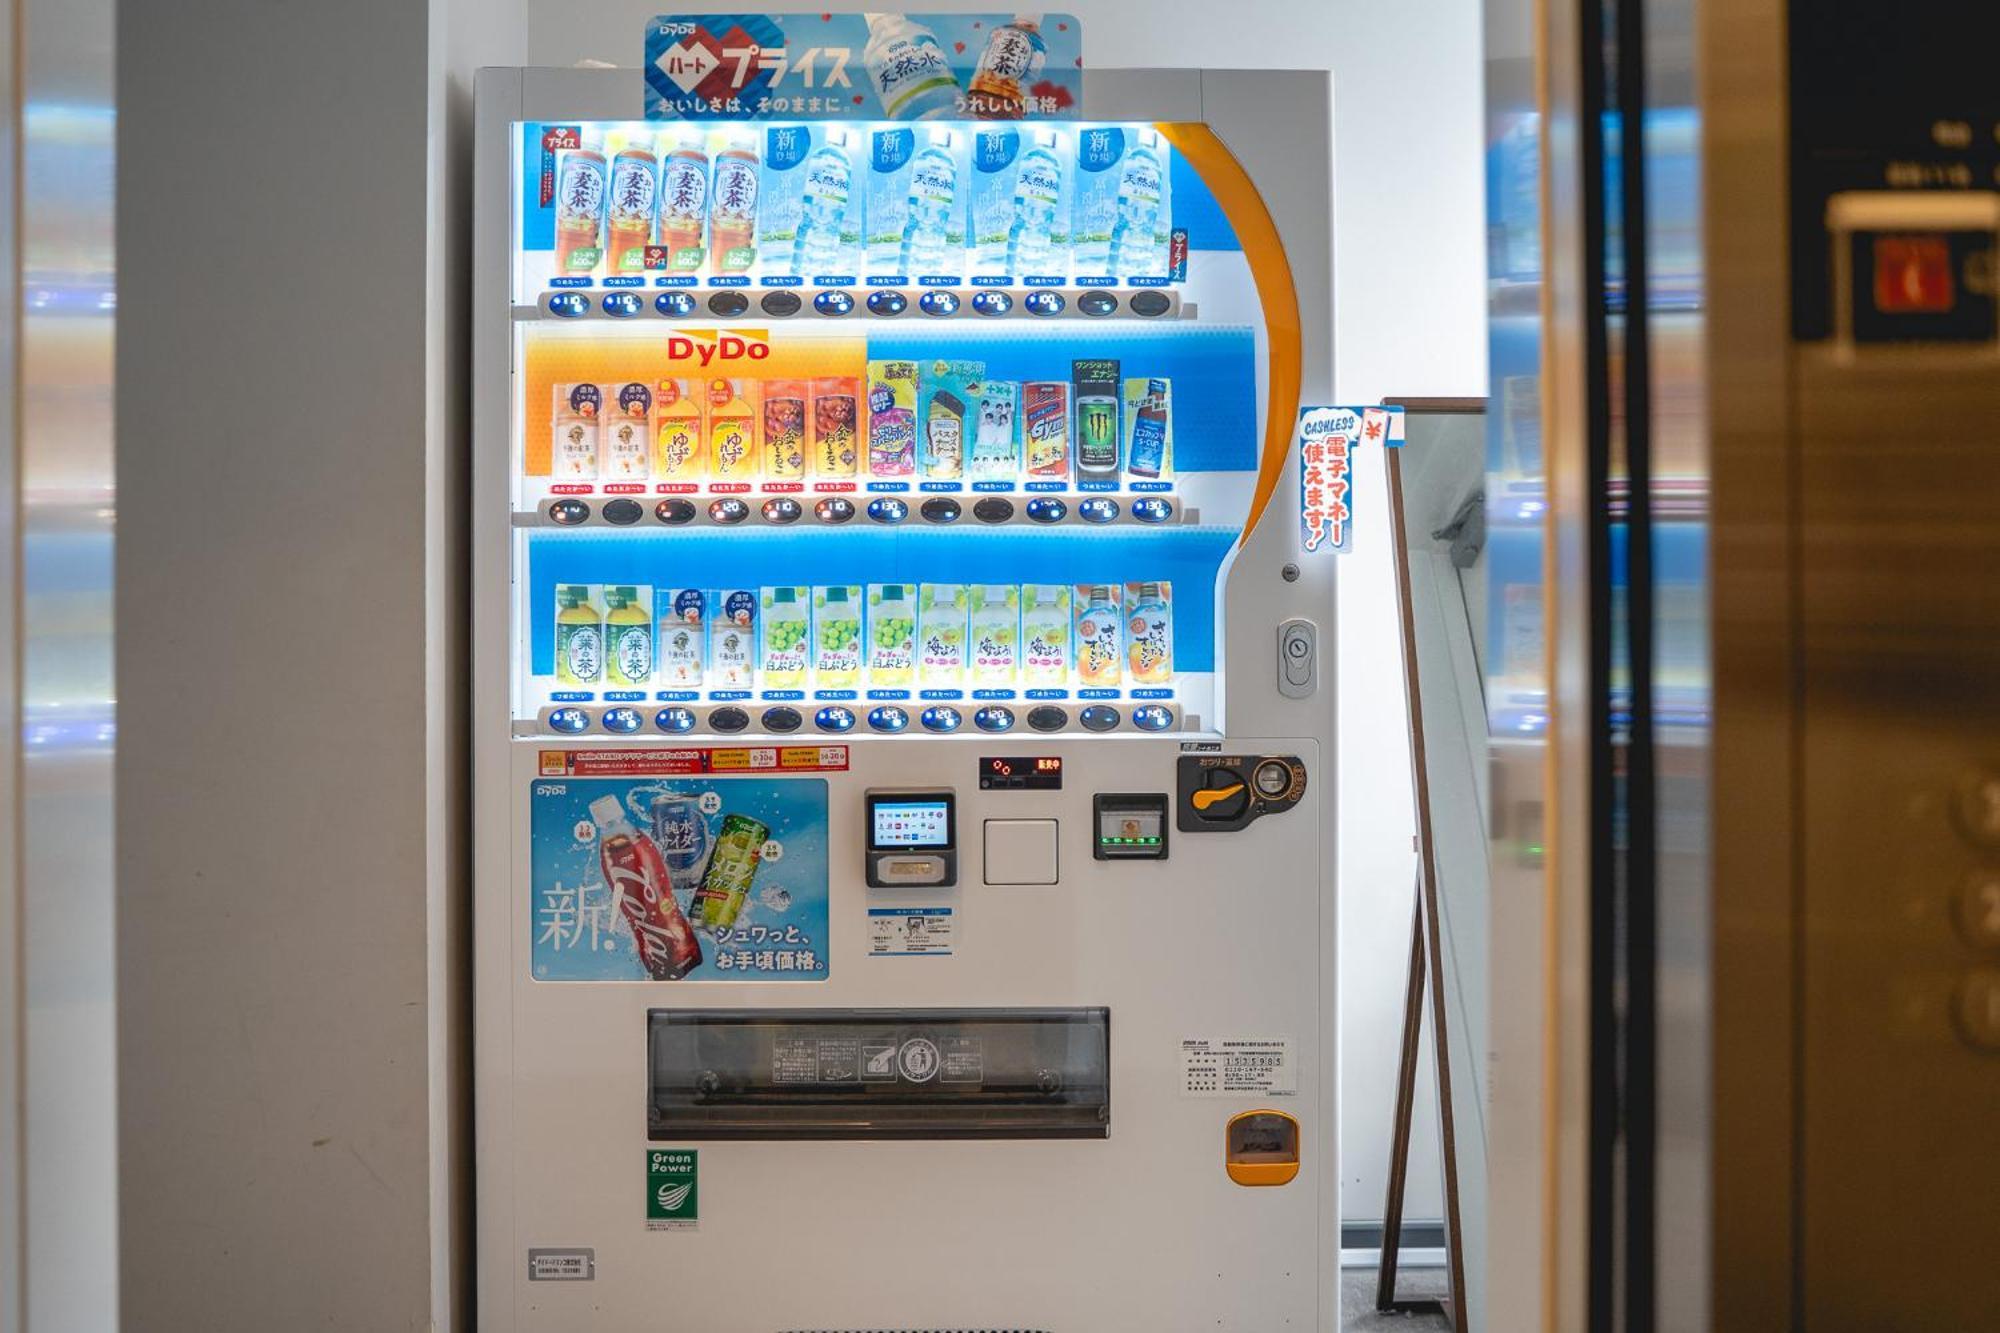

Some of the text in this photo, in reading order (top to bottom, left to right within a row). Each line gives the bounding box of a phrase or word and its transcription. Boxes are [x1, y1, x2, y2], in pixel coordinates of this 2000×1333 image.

[660, 23, 696, 36] DyDo
[669, 57, 706, 74] ハート
[722, 44, 852, 88] プライス
[880, 53, 941, 92] 天然水
[659, 97, 850, 113] おいしさは、そのままに。
[777, 130, 796, 150] 新
[881, 134, 900, 152] 新
[985, 133, 1005, 152] 新
[1089, 131, 1109, 151] 新
[571, 171, 592, 208] 麦茶
[622, 171, 644, 208] 麦茶
[675, 171, 697, 208] 麦茶
[725, 171, 747, 208] 麦茶
[808, 173, 849, 190] 天然水
[914, 173, 953, 190] 天然水
[1019, 173, 1057, 190] 天然水
[1123, 173, 1159, 190] 天然水
[668, 337, 770, 367] DyDo
[1304, 416, 1355, 435] CASHLESS
[1326, 436, 1346, 543] 電子マネー
[664, 820, 693, 834] 純水
[661, 835, 702, 849] サイダー
[716, 925, 810, 944] シュワっと、
[716, 950, 824, 971] お手頃価格。
[652, 1153, 691, 1162] Green
[652, 1163, 692, 1173] Power
